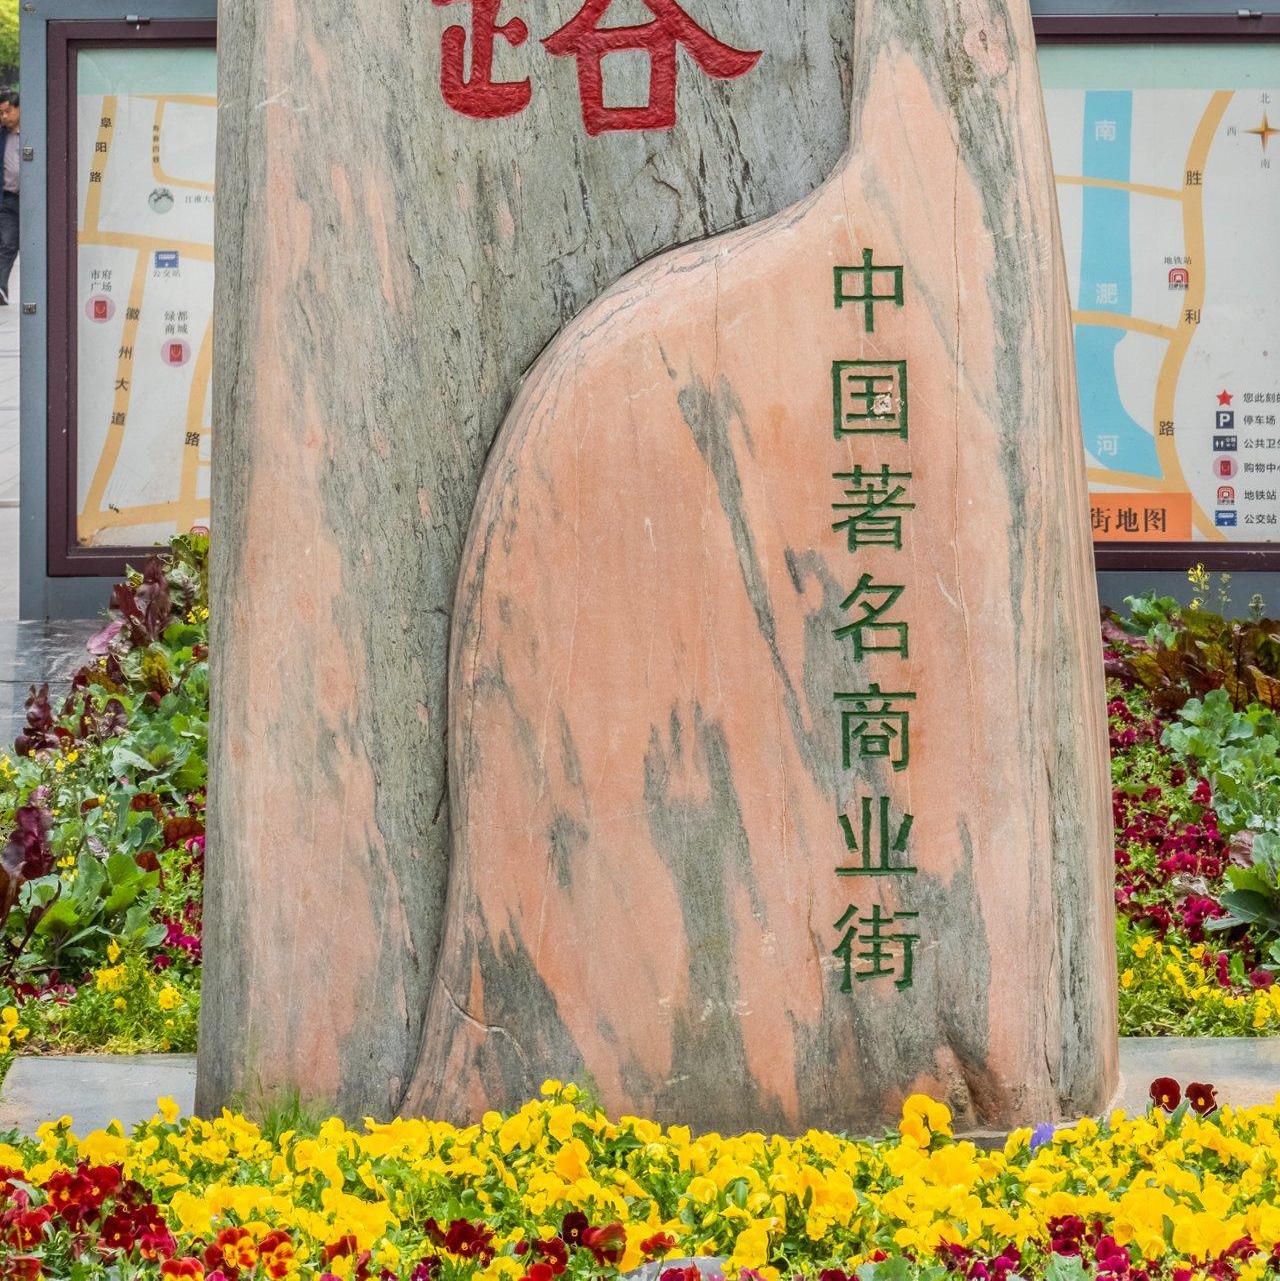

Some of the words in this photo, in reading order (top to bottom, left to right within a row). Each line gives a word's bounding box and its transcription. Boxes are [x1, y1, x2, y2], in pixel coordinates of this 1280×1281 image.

[1260, 93, 1271, 105] 北
[1227, 126, 1238, 138] 西
[89, 118, 113, 183] 阜阳路
[1260, 158, 1271, 170] 南
[1163, 255, 1193, 266] 地铁站
[90, 269, 113, 280] 市府
[152, 269, 181, 279] 公交站
[90, 281, 113, 292] 广场
[1093, 120, 1119, 457] 南淝河
[1159, 171, 1203, 438] 胜利路
[164, 310, 189, 321] 绿都
[164, 322, 189, 334] 商城
[111, 308, 140, 427] 徽州大道
[1243, 414, 1276, 426] 停车场
[185, 432, 201, 447] 路
[1244, 489, 1277, 502] 地铁站
[1090, 505, 1167, 534] 街地图
[1245, 513, 1277, 526] 公交站
[831, 247, 921, 994] 中国著名商业街
